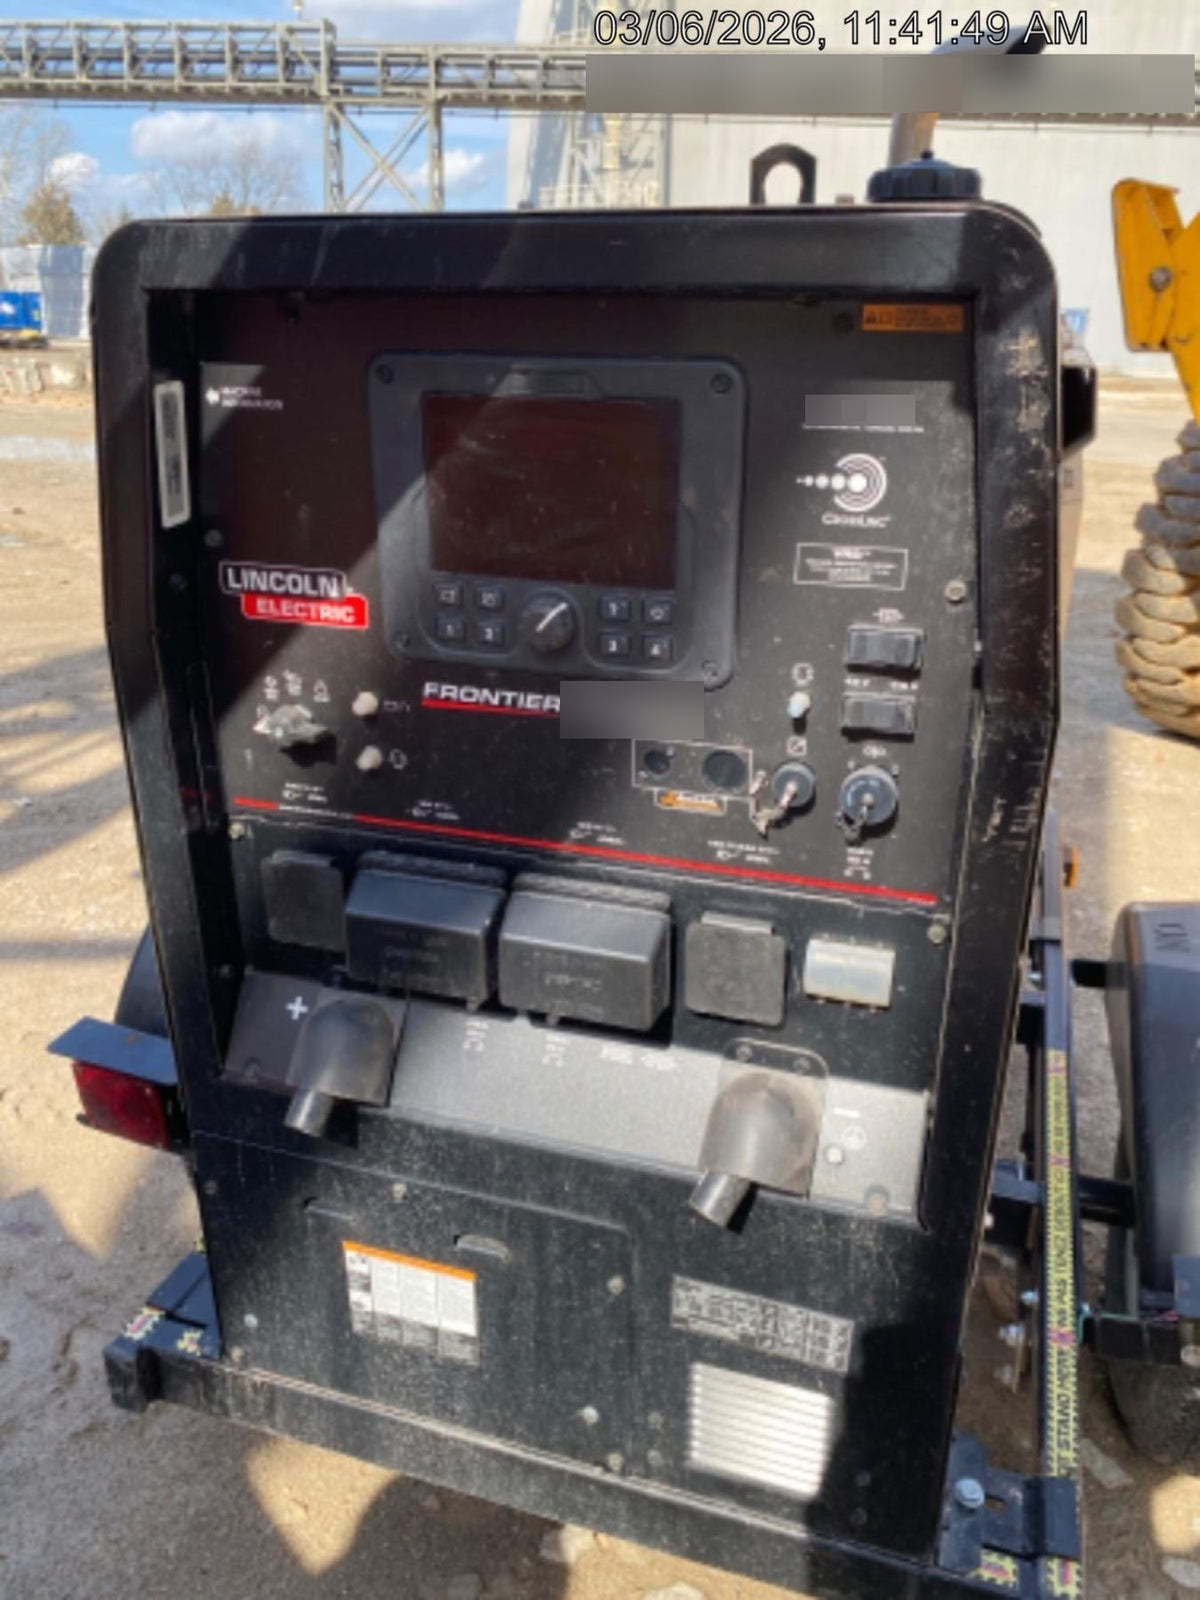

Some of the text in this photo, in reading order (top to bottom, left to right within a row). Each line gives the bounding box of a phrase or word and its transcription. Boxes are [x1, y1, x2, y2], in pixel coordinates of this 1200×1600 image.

[227, 567, 339, 598] LINCOLN
[256, 596, 355, 623] ELECTRIC
[423, 681, 560, 713] FRONTIER
[1056, 1393, 1070, 1451] STAND
